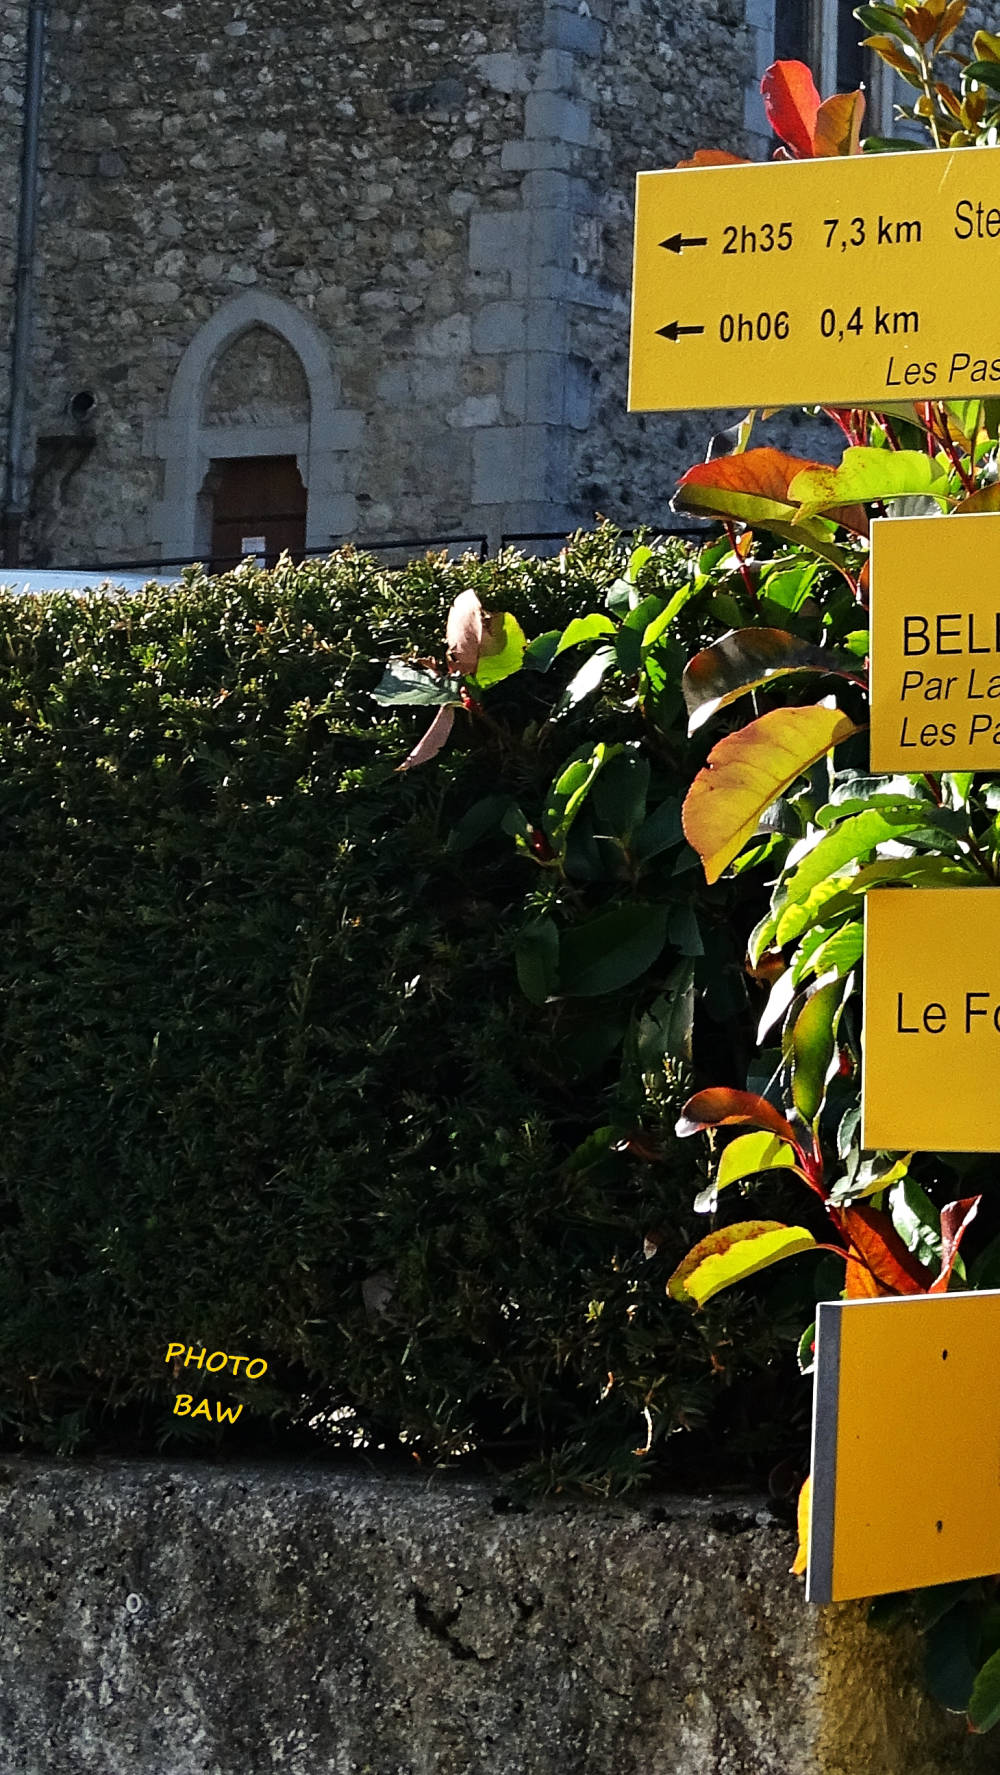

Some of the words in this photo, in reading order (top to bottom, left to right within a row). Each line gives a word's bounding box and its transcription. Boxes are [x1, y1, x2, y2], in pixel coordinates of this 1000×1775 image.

[722, 222, 793, 255] 2h35
[823, 217, 866, 253] 7,3
[877, 215, 922, 245] km
[719, 310, 790, 343] 0h06
[820, 306, 864, 343] 0,4
[875, 305, 919, 335] km
[885, 356, 938, 386] Les
[900, 670, 958, 701] Par
[900, 716, 957, 747] Les
[897, 992, 947, 1034] Le
